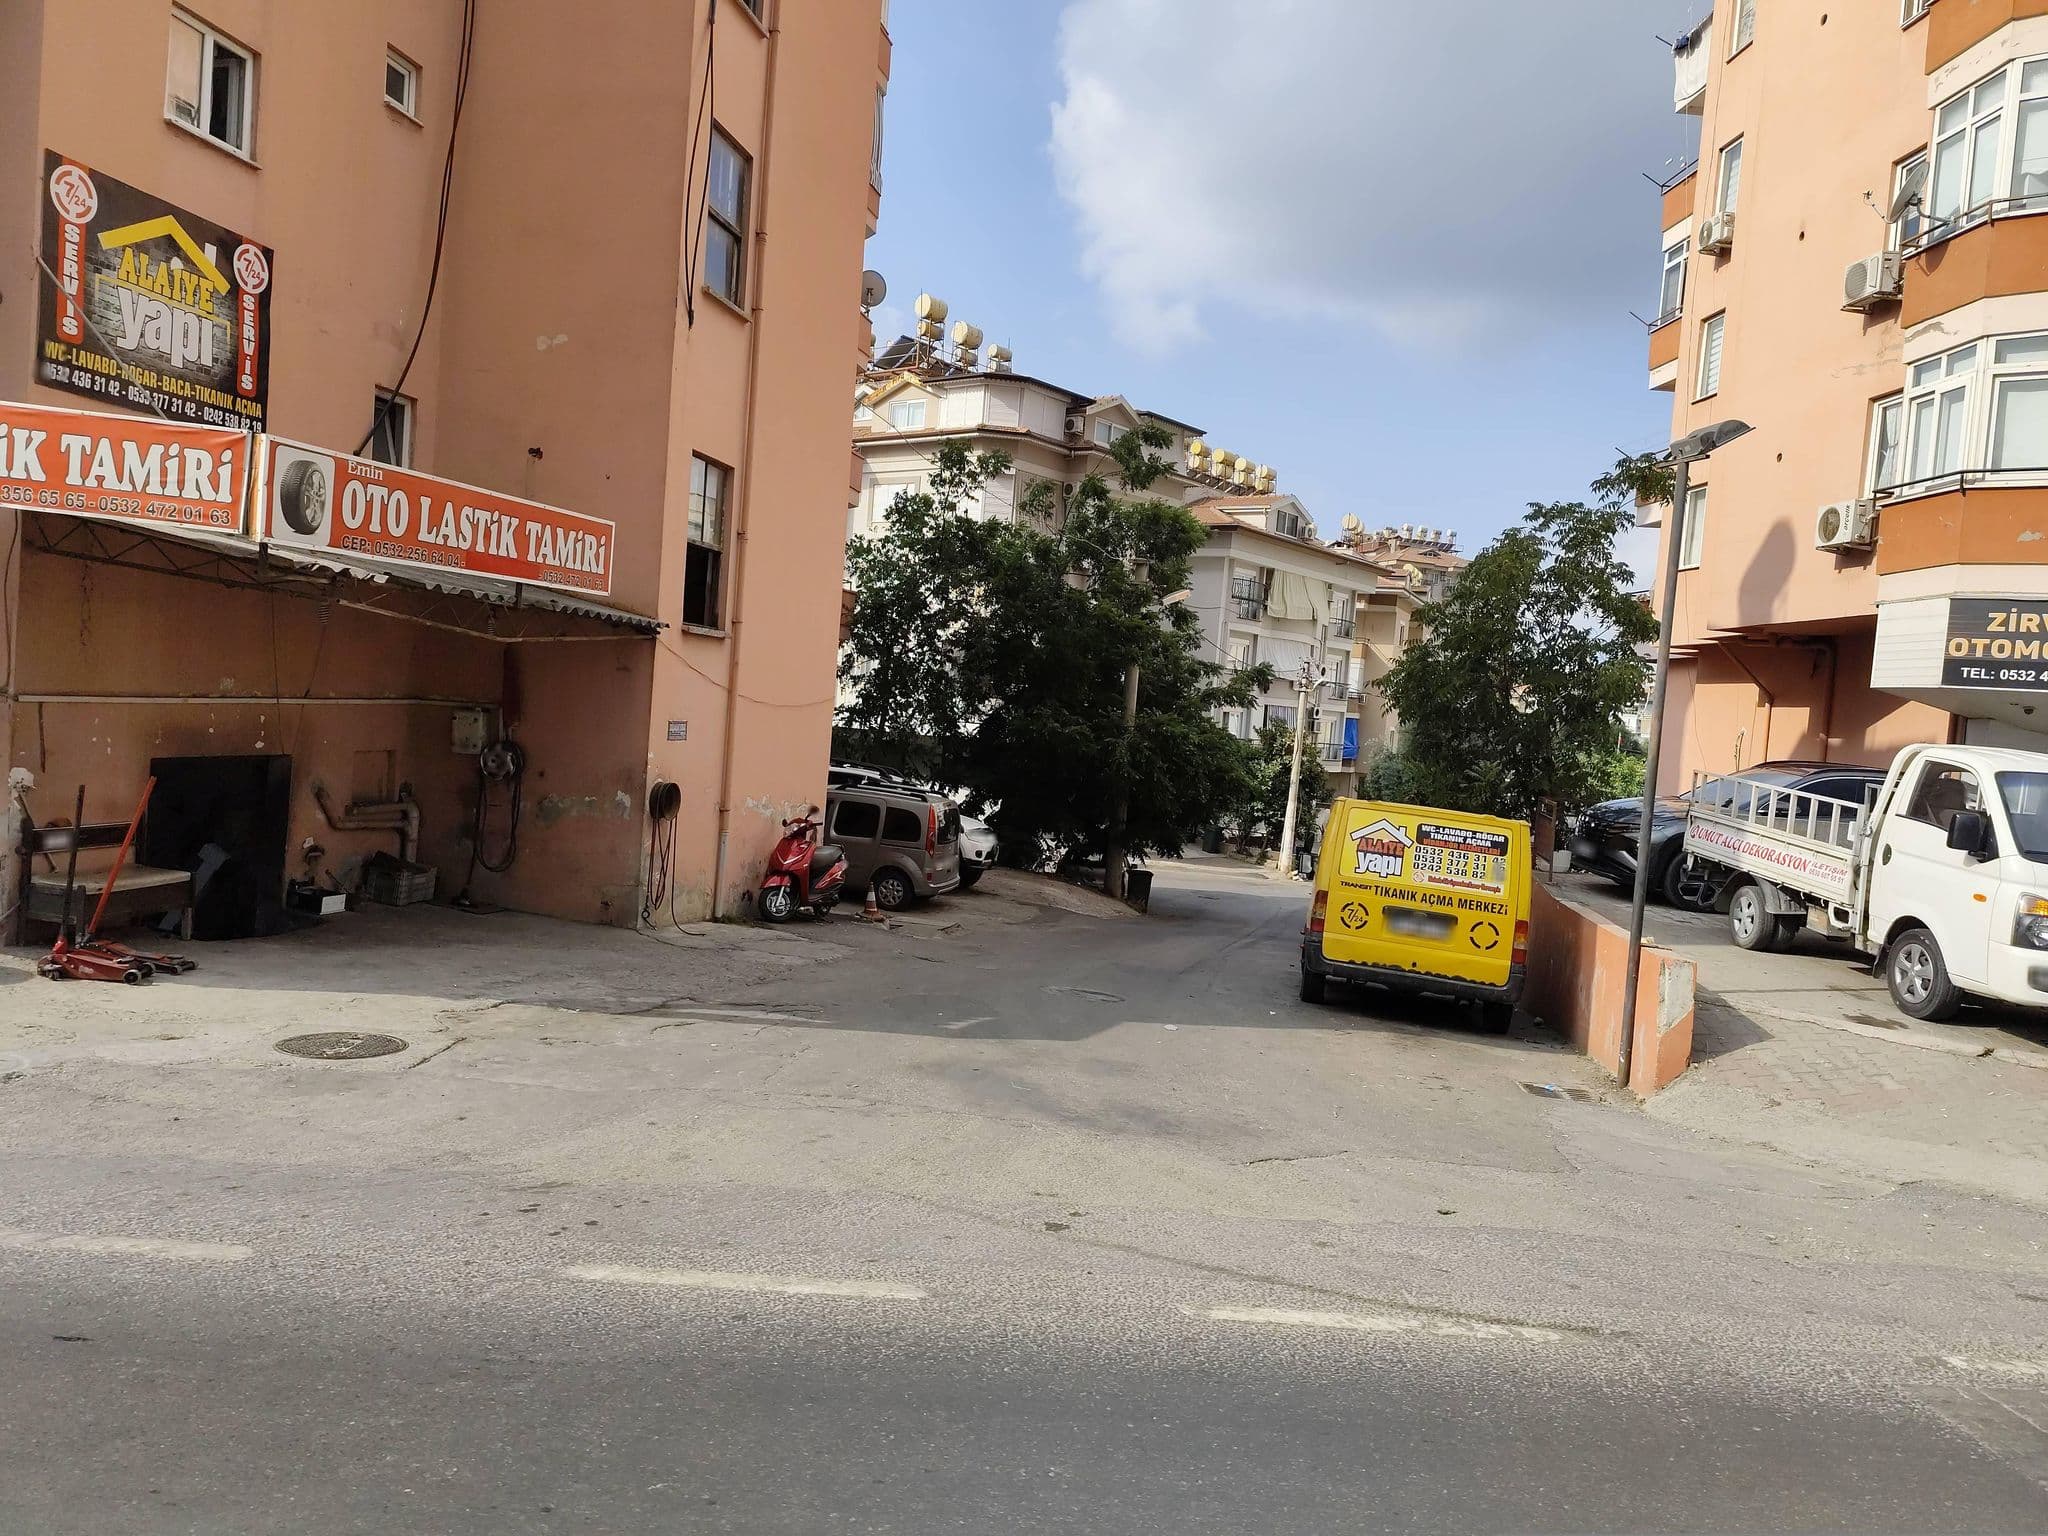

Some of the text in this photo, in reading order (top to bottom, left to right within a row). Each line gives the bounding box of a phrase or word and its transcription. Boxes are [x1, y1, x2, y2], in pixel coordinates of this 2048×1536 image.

[72, 370, 91, 389] 436
[94, 375, 106, 393] 31
[108, 380, 120, 397] 42
[152, 392, 169, 410] 377
[171, 398, 182, 414] 31
[184, 402, 196, 417] 42
[204, 406, 223, 425] 0242
[225, 411, 239, 429] 538
[240, 415, 250, 431] 82
[252, 421, 262, 433] 19
[235, 398, 262, 418] AÇMA
[347, 460, 383, 480] Emin
[2, 486, 33, 504] 356
[39, 489, 59, 506] 65
[146, 501, 178, 519] 472
[183, 507, 204, 522] 01
[210, 509, 231, 525] 63
[342, 479, 409, 537] OTO
[341, 535, 371, 553] CEP:
[374, 541, 404, 558] 0532
[407, 546, 428, 562] 256
[431, 551, 445, 565] 64
[1948, 638, 2048, 660] OTOM
[1961, 667, 1995, 679] TEL:
[2000, 669, 2036, 681] 0532
[1430, 833, 1492, 847] TIKANIK AÇMA
[1698, 827, 1723, 845] UMUT
[1741, 842, 1811, 873] DEKORASYON
[1414, 854, 1443, 864] 0533
[1447, 859, 1468, 868] 377
[1473, 862, 1486, 871] 31
[1415, 846, 1444, 856] 0532
[1448, 851, 1469, 860] 436
[1474, 854, 1487, 863] 31
[1413, 862, 1442, 872] 0242
[1446, 867, 1467, 876] 538
[1472, 870, 1486, 879] 82
[1374, 885, 1418, 902] TIKANIK
[1420, 893, 1454, 908] AÇMA
